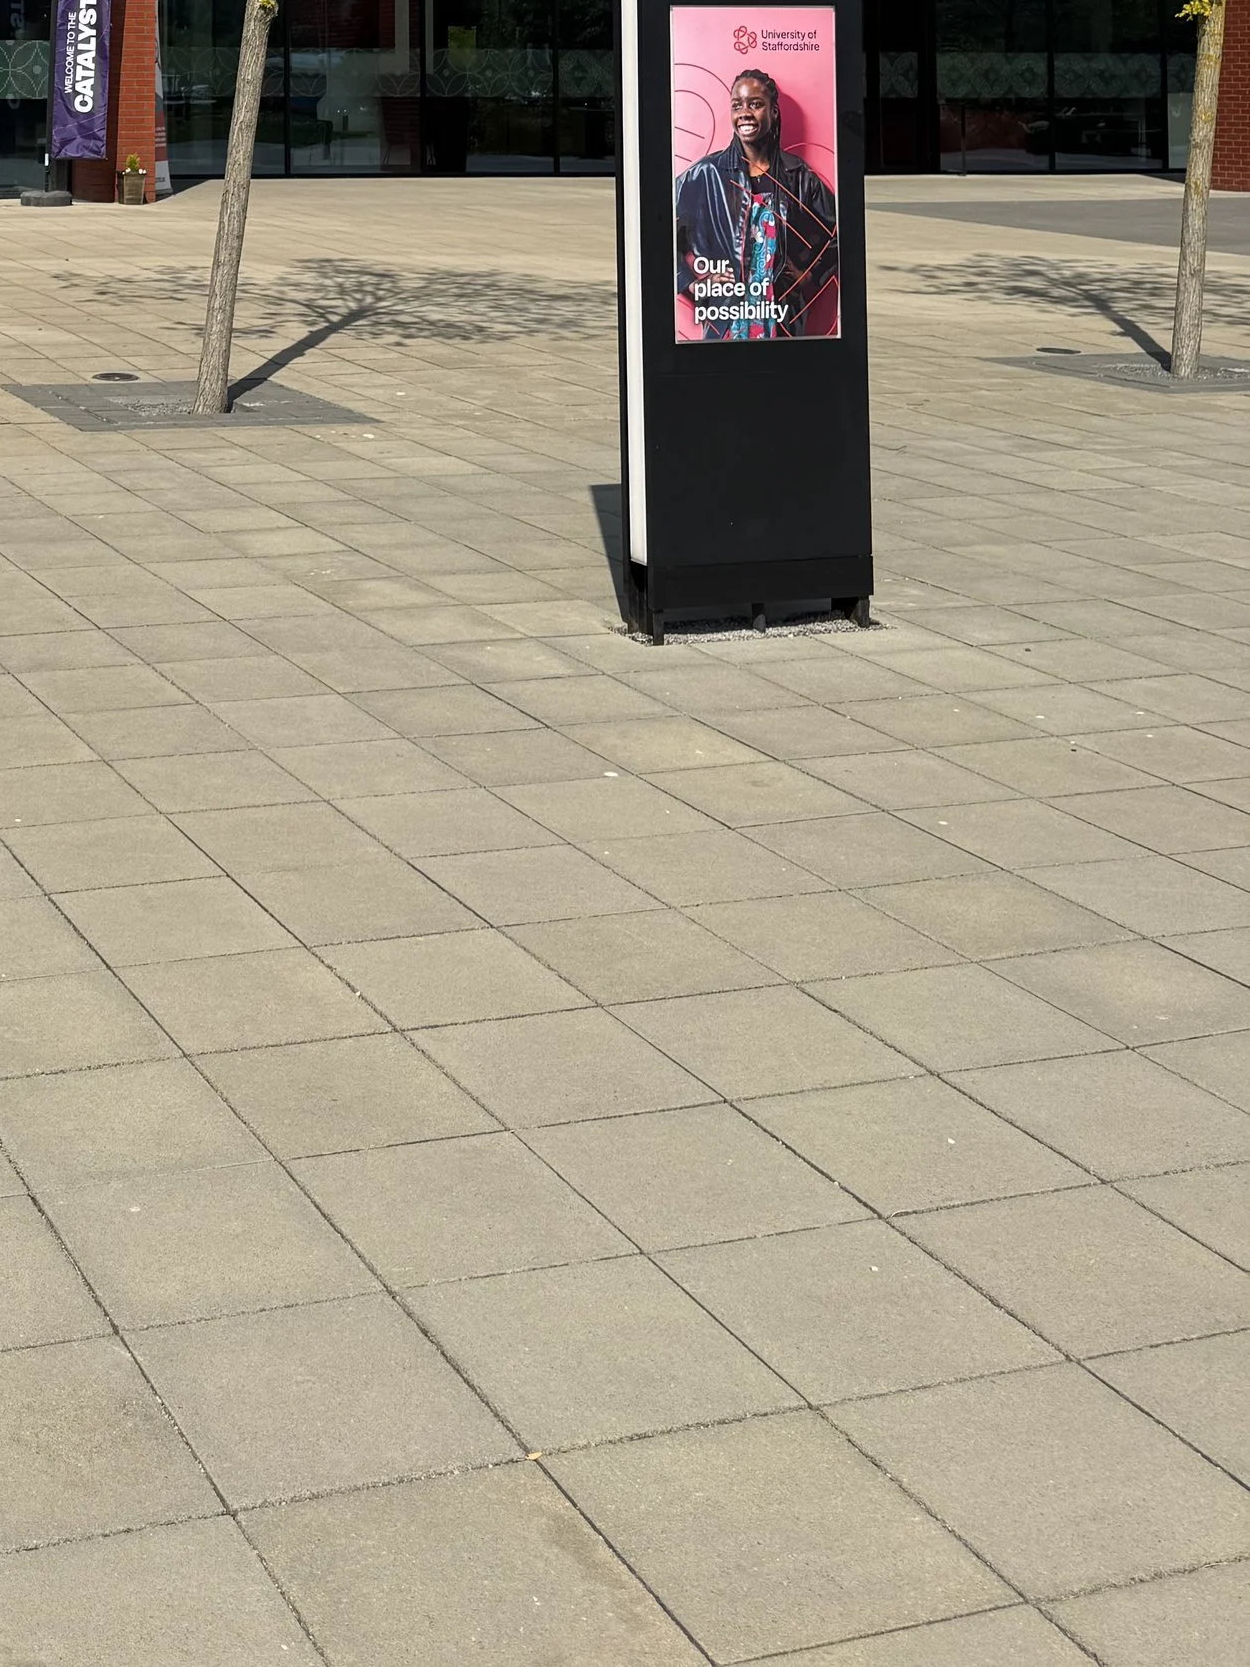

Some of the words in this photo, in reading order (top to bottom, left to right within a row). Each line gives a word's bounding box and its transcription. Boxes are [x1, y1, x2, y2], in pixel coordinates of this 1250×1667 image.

[68, 12, 77, 29] THE
[67, 31, 75, 47] TO
[761, 30, 805, 41] University
[807, 30, 817, 39] of
[762, 41, 820, 51] Staffordshire
[64, 47, 75, 94] WELCOME
[693, 256, 729, 275] Our
[694, 278, 745, 301] place
[750, 277, 769, 296] of
[694, 301, 789, 324] possibility
